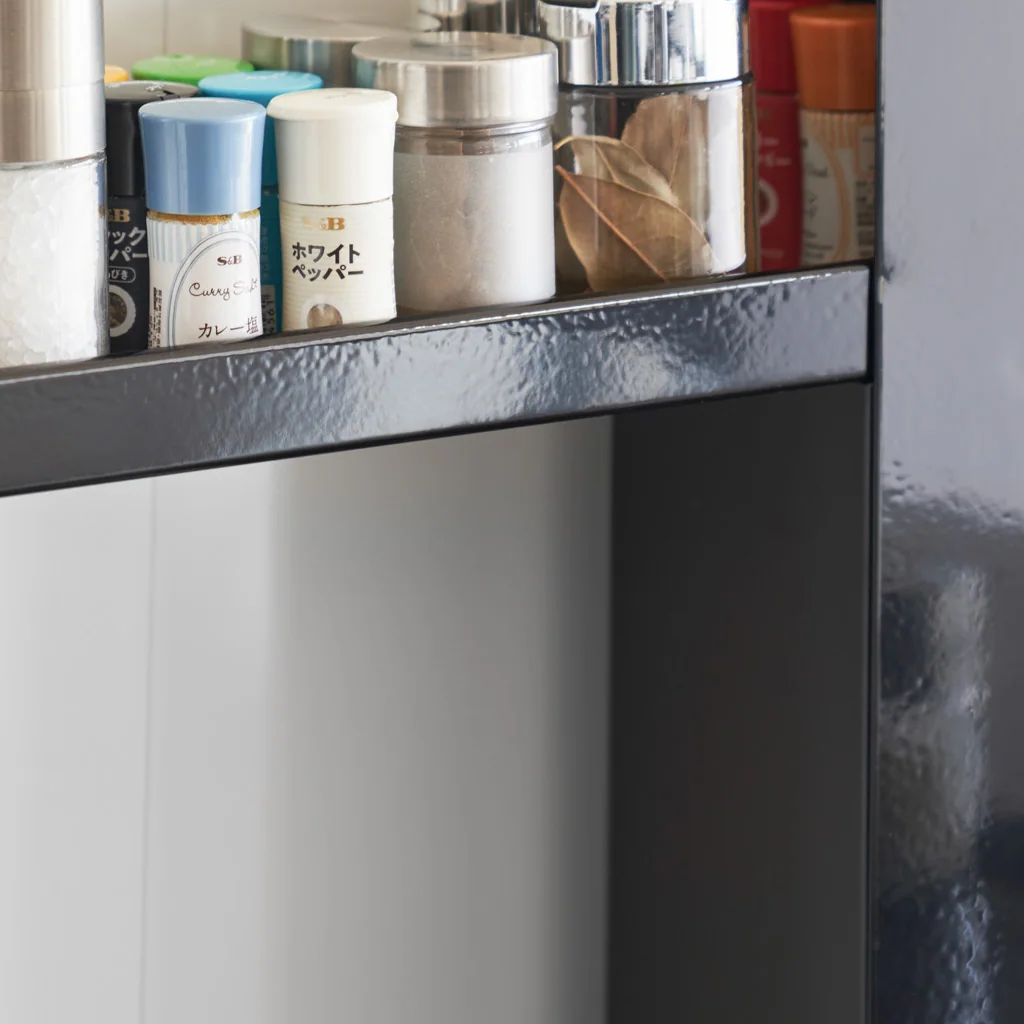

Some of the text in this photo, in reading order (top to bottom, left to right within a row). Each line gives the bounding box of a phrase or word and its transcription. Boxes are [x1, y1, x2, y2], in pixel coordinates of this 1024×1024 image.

[108, 226, 146, 247] ック
[109, 246, 148, 262] パー
[217, 255, 242, 266] S&B
[292, 242, 361, 264] ホワイト
[292, 264, 364, 282] ペッパー
[188, 282, 231, 301] Curry
[198, 316, 259, 339] カレー塩
